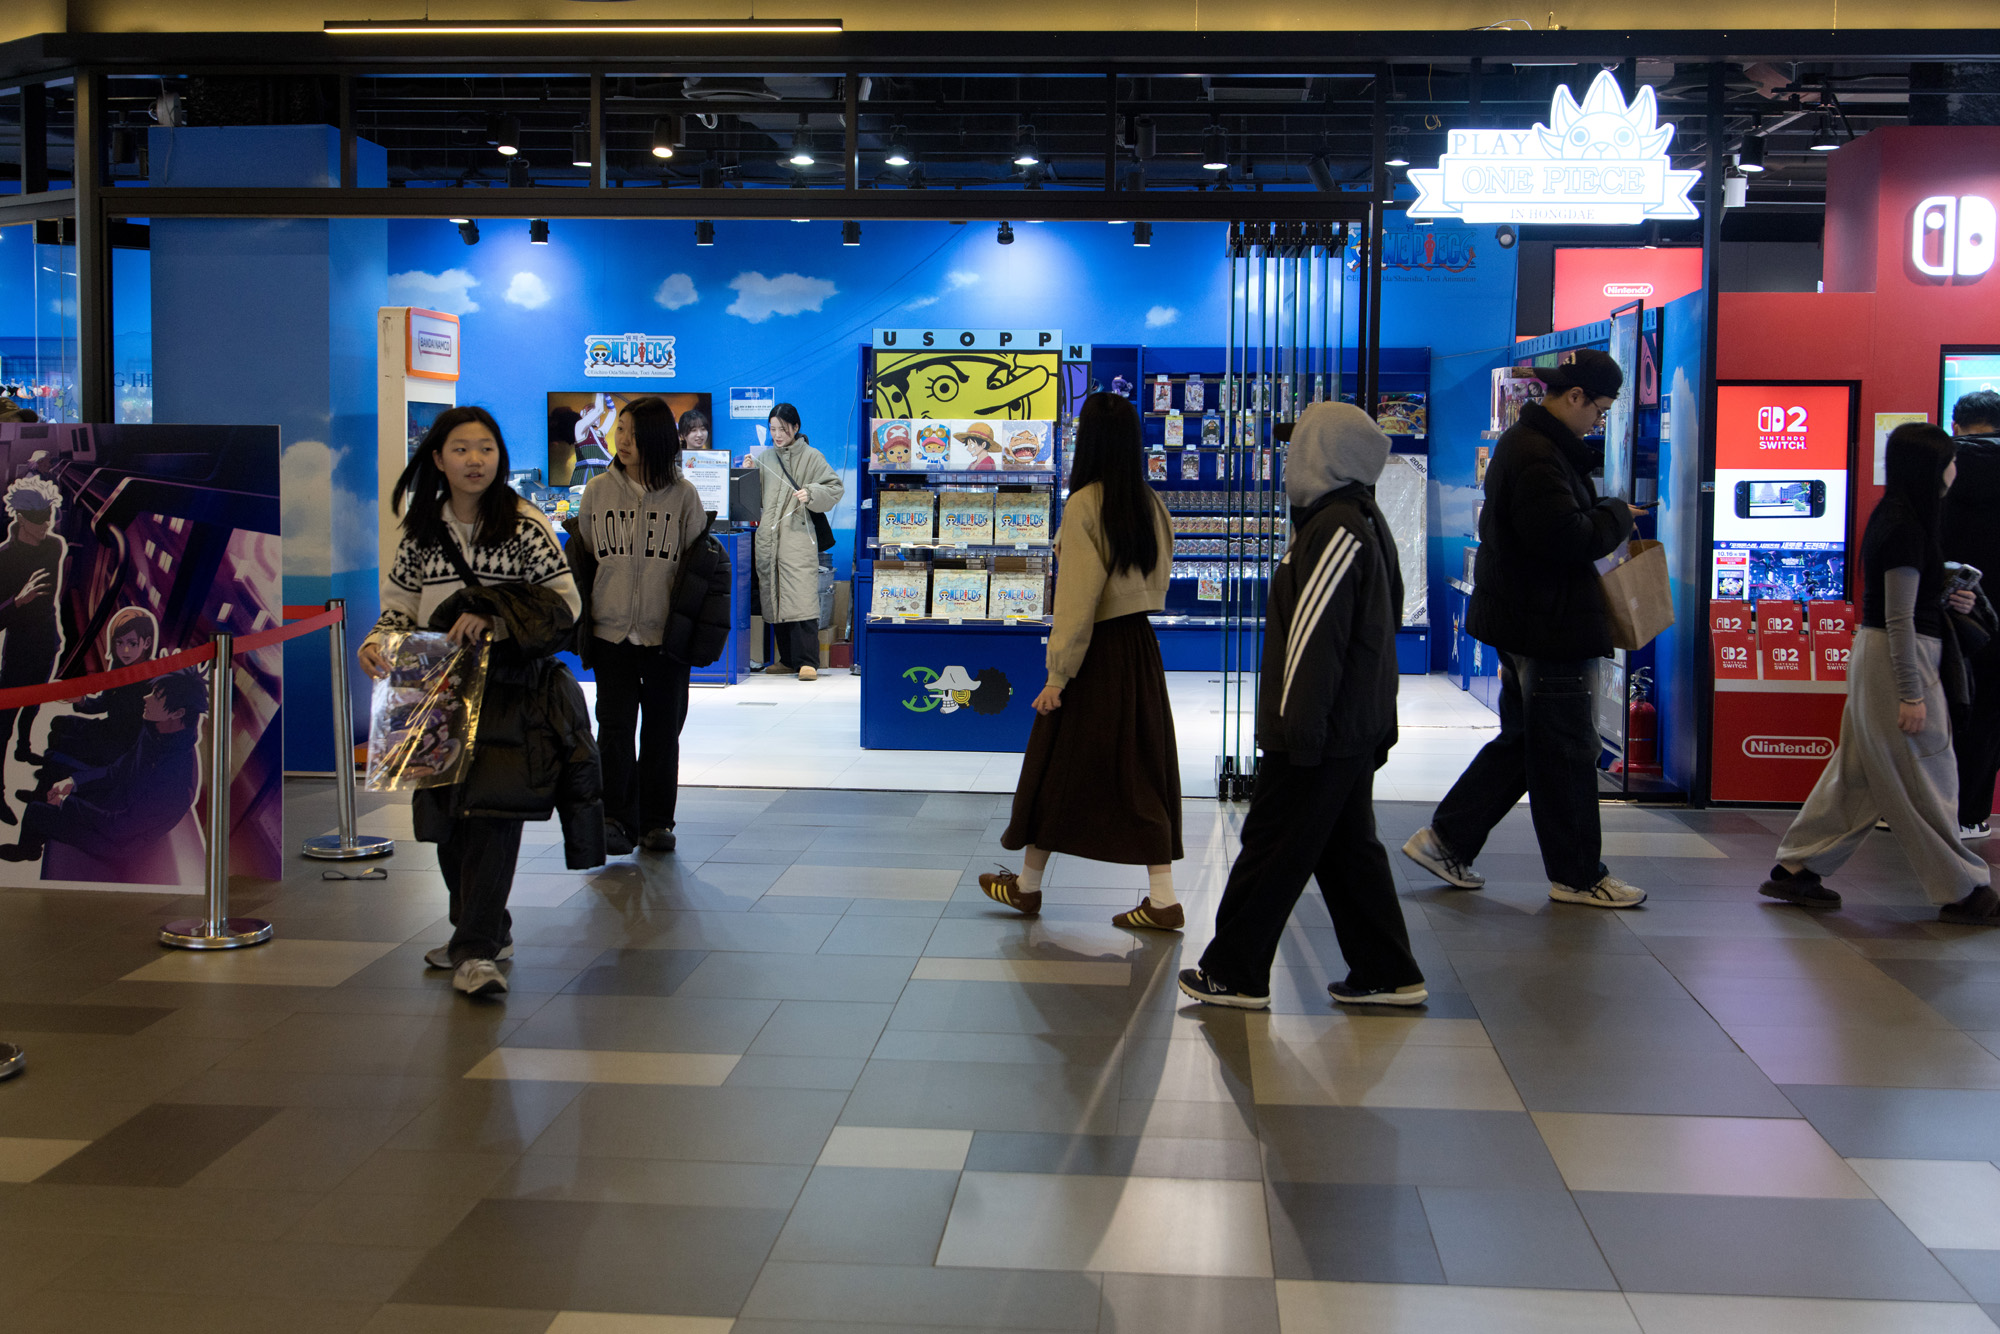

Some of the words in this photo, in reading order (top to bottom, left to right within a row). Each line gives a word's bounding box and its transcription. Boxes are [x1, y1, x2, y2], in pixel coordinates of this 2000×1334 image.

[1452, 133, 1530, 155] PLAY
[1462, 166, 1534, 194] ONE
[1543, 166, 1645, 195] PIECE
[1510, 209, 1523, 219] IN
[1526, 209, 1595, 220] HONGDAE
[1607, 285, 1649, 294] Nintendo
[882, 331, 1052, 347] USOPP
[589, 341, 629, 363] ONE
[630, 342, 673, 363] PIECE
[1759, 441, 1806, 450] SWITCH
[906, 513, 928, 526] PIECE
[966, 513, 988, 526] PIECE
[1022, 514, 1043, 527] PIECE
[900, 587, 919, 598] PIECE
[960, 589, 982, 601] PIECE
[1017, 589, 1037, 600] PIECE
[1750, 740, 1827, 754] Nintendo
